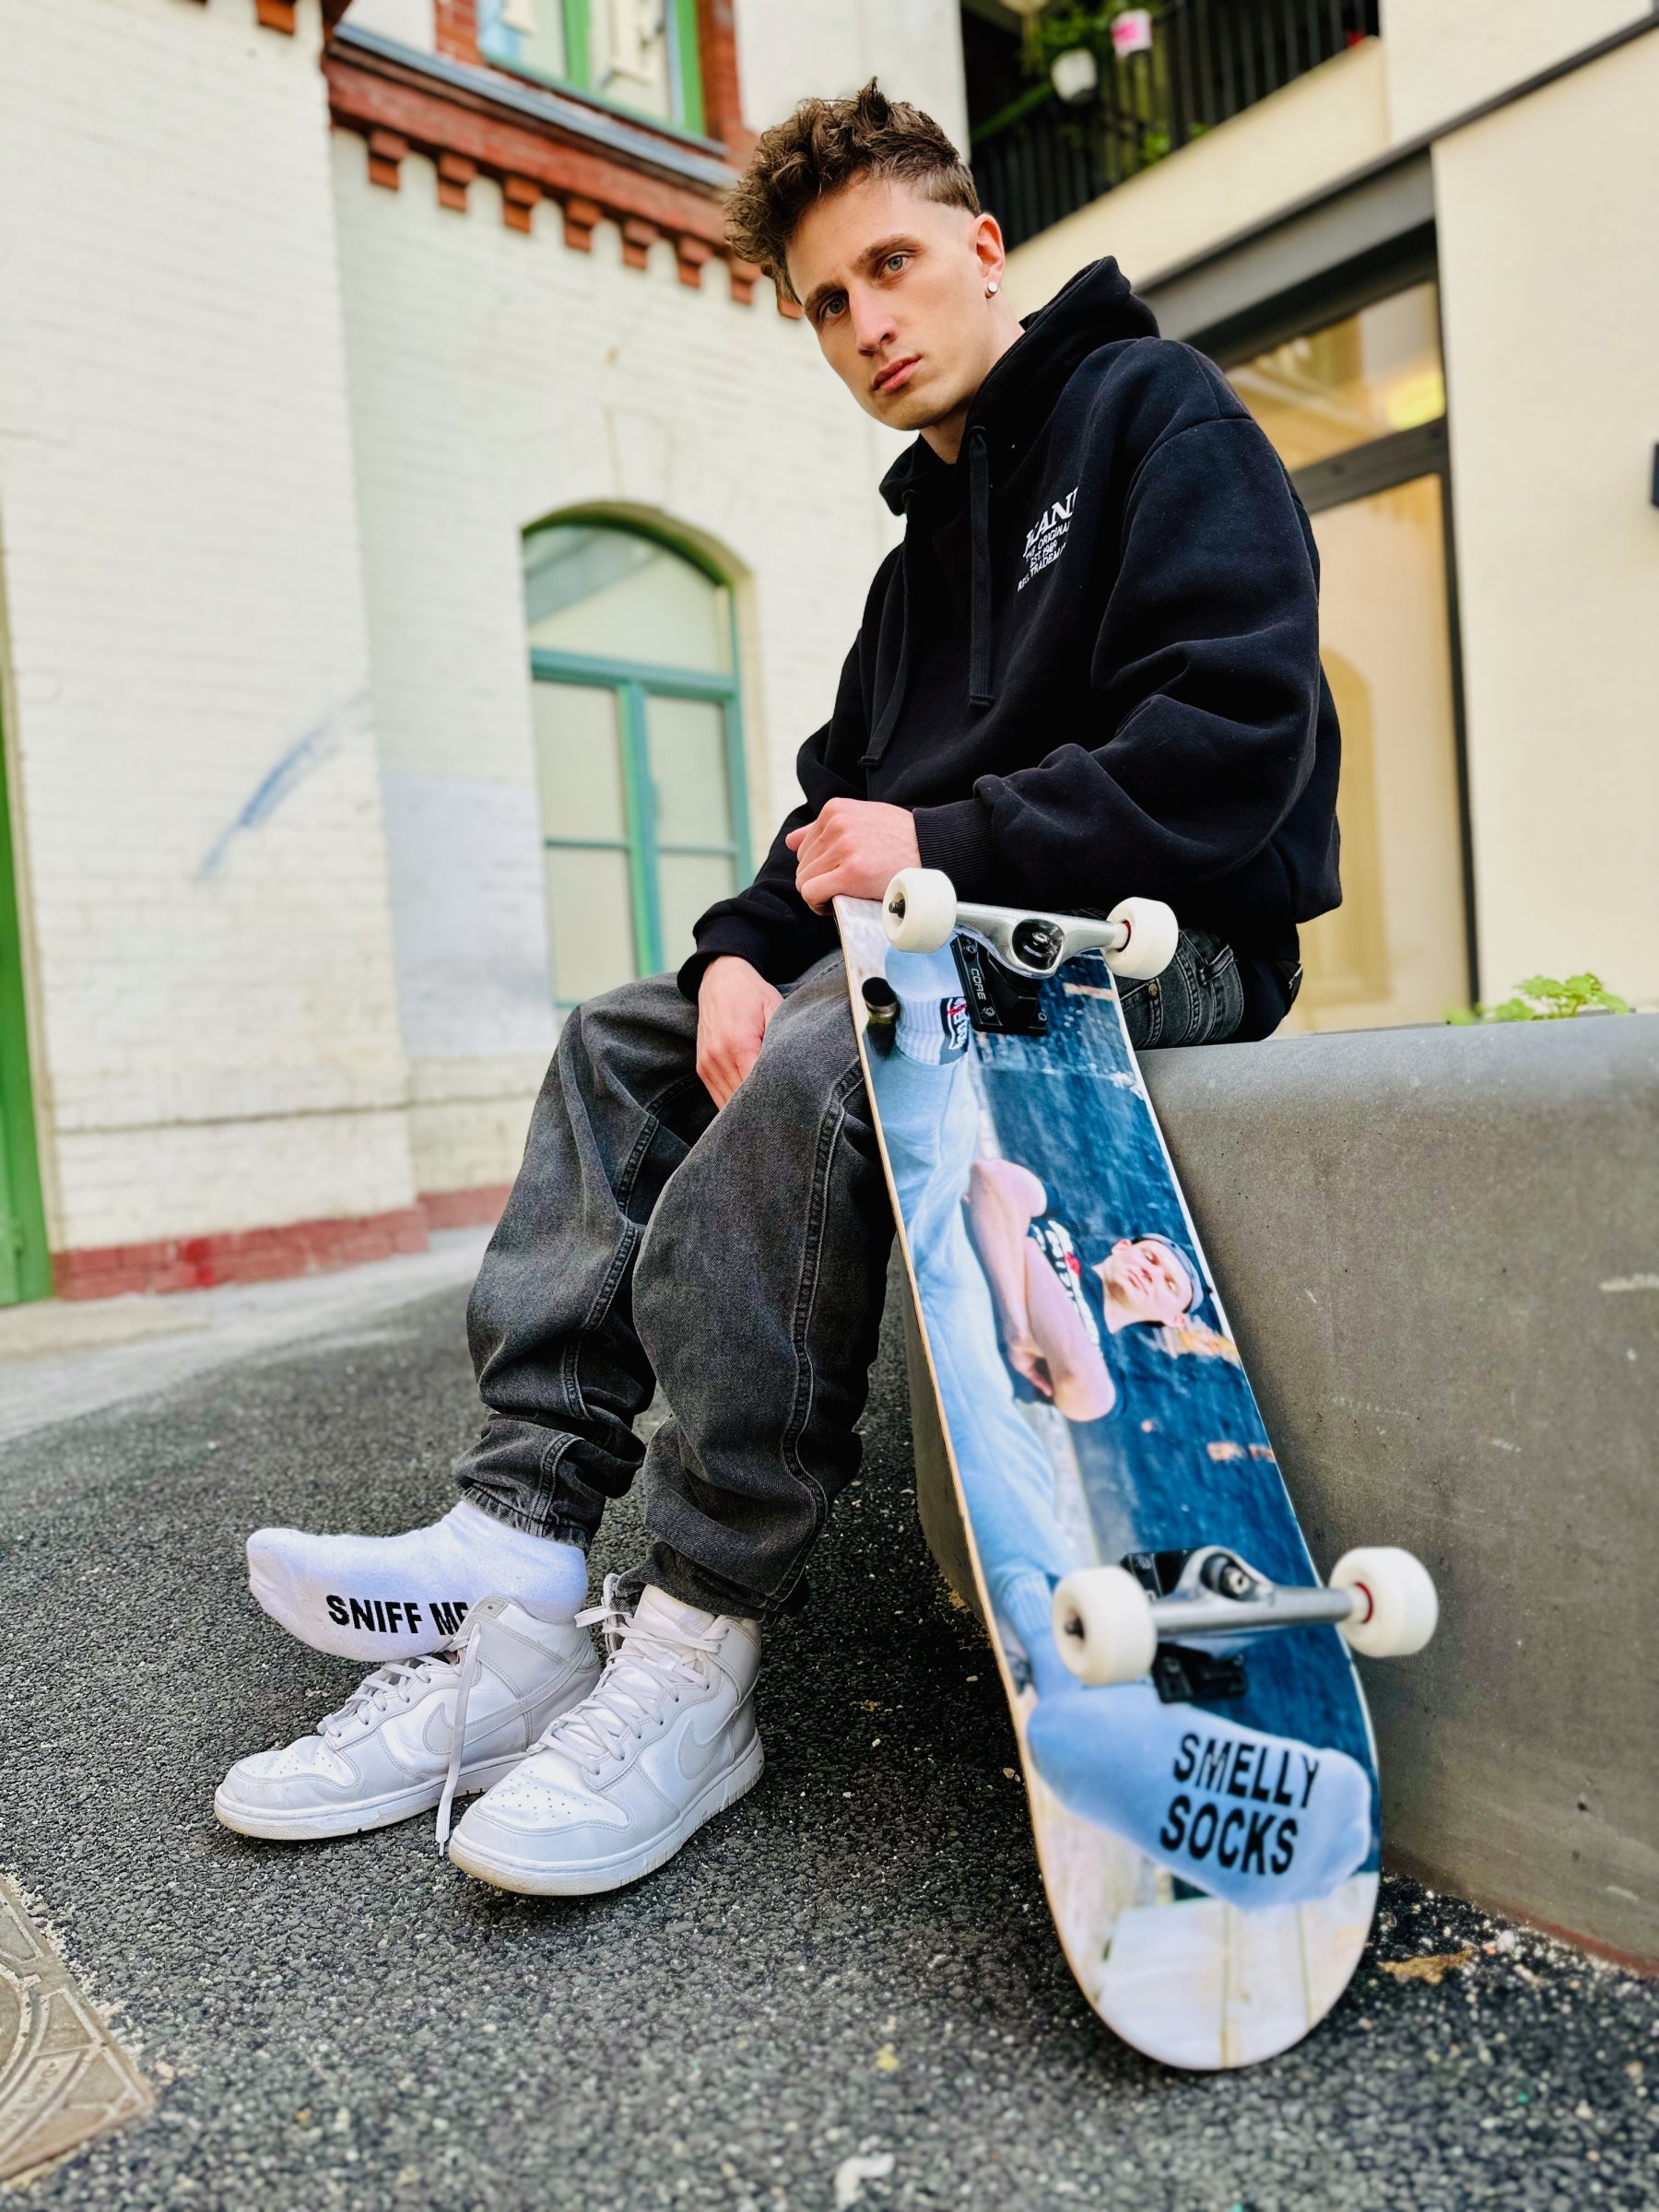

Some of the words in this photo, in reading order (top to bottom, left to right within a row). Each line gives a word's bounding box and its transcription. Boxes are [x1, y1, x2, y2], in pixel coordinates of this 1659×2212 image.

[971, 968, 987, 1000] CORE
[325, 1594, 423, 1634] SNIFF
[1173, 1733, 1320, 1808] SMELLY
[1160, 1794, 1299, 1876] SOCKS
